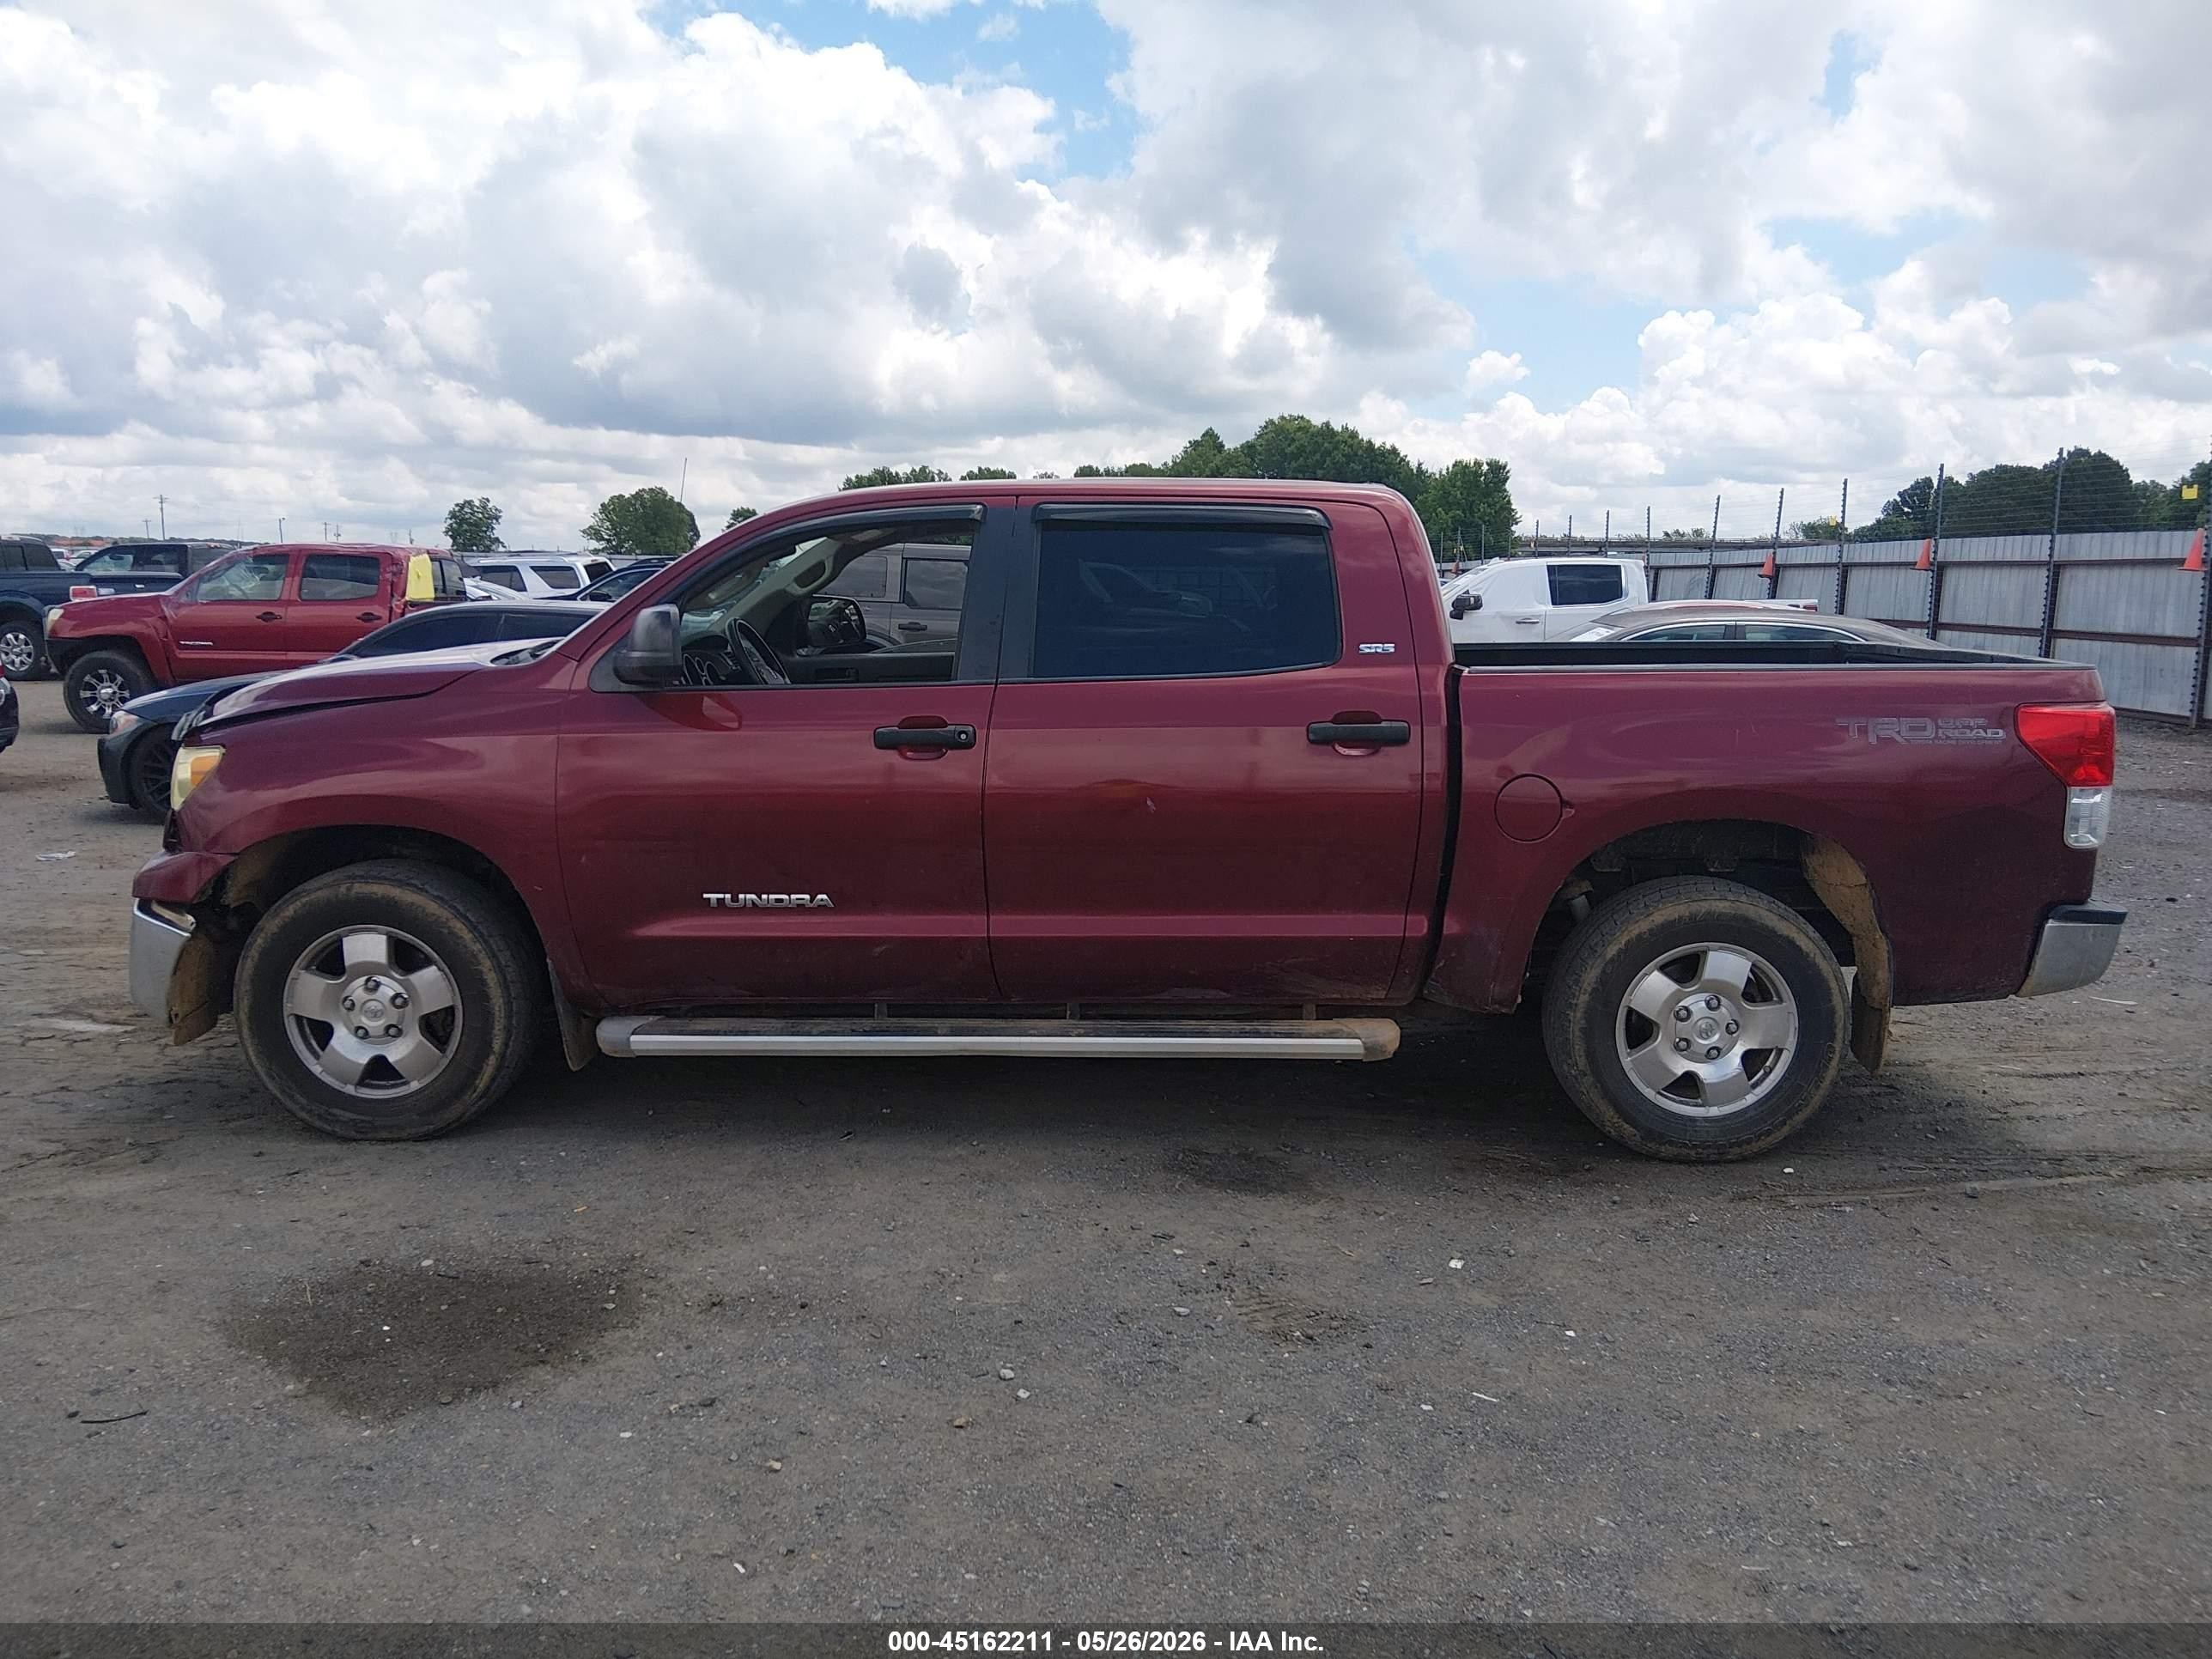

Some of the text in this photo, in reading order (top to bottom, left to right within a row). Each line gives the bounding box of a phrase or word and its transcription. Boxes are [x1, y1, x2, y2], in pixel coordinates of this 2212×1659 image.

[1834, 717, 1936, 744] TRD
[1937, 728, 2007, 739] ROAD
[702, 893, 835, 908] TUNDRA
